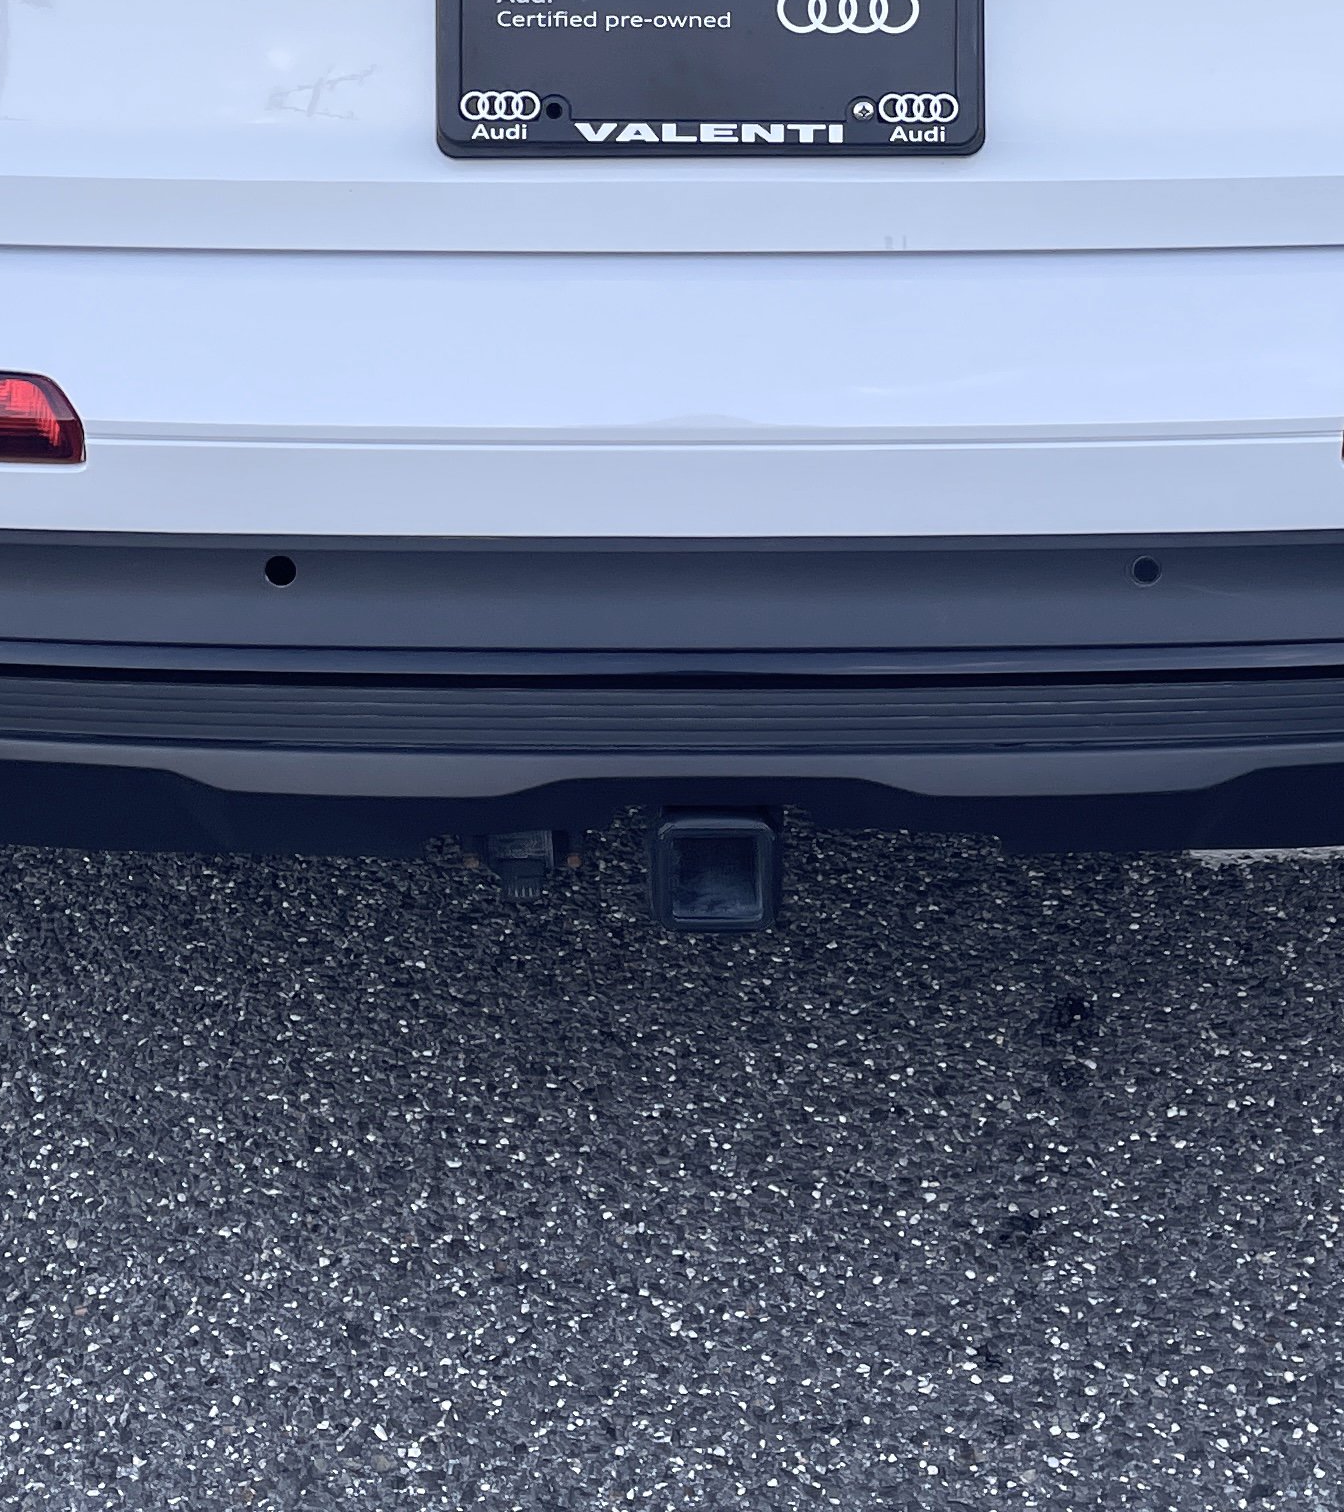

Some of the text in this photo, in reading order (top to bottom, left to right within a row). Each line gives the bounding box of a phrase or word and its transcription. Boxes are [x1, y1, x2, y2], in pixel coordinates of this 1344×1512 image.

[496, 10, 731, 31] Certified pre-owned
[471, 123, 528, 141] Audi
[573, 122, 845, 144] VALENTI
[889, 125, 946, 143] Audi
